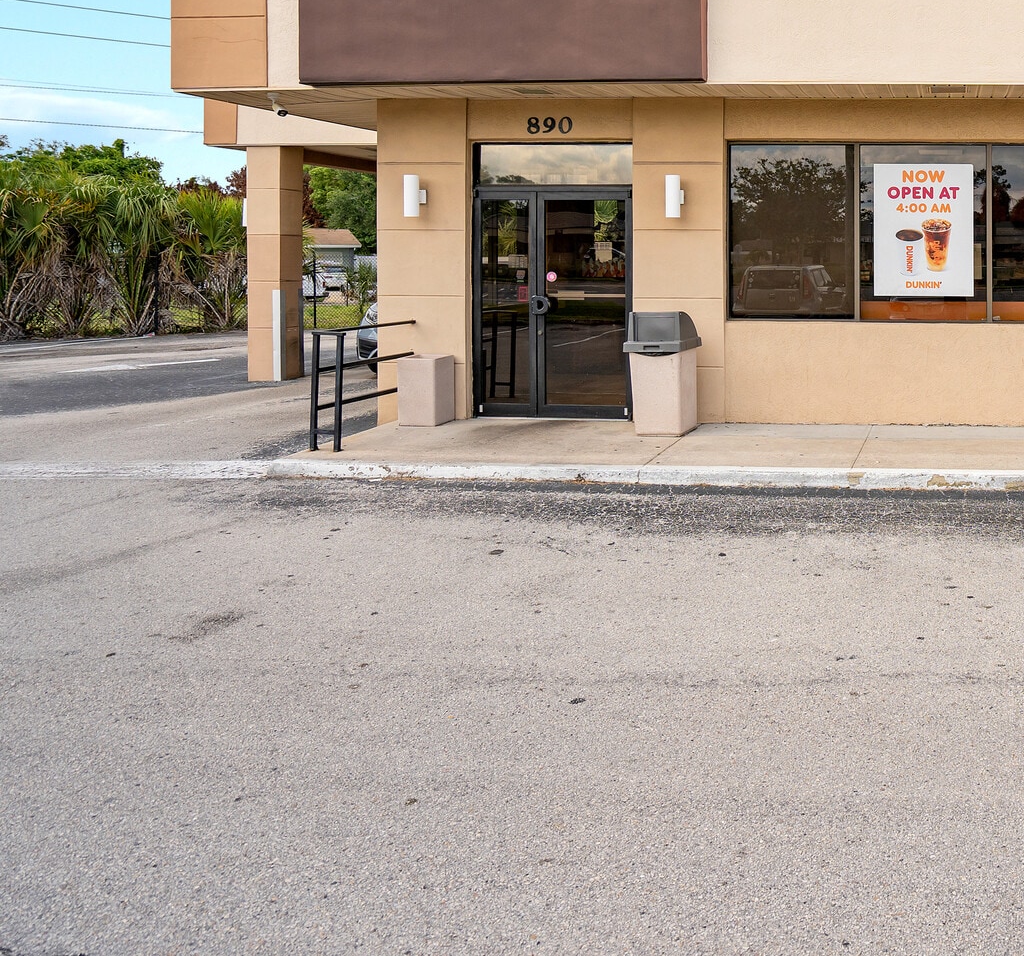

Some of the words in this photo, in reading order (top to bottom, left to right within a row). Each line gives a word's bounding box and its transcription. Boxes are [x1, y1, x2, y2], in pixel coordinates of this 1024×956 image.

[527, 116, 573, 134] 890
[902, 170, 945, 183] NOW
[887, 186, 934, 199] OPEN
[939, 186, 960, 199] AT
[895, 203, 927, 213] 4:00
[930, 203, 951, 213] AM
[905, 281, 942, 289] DUNKIN'
